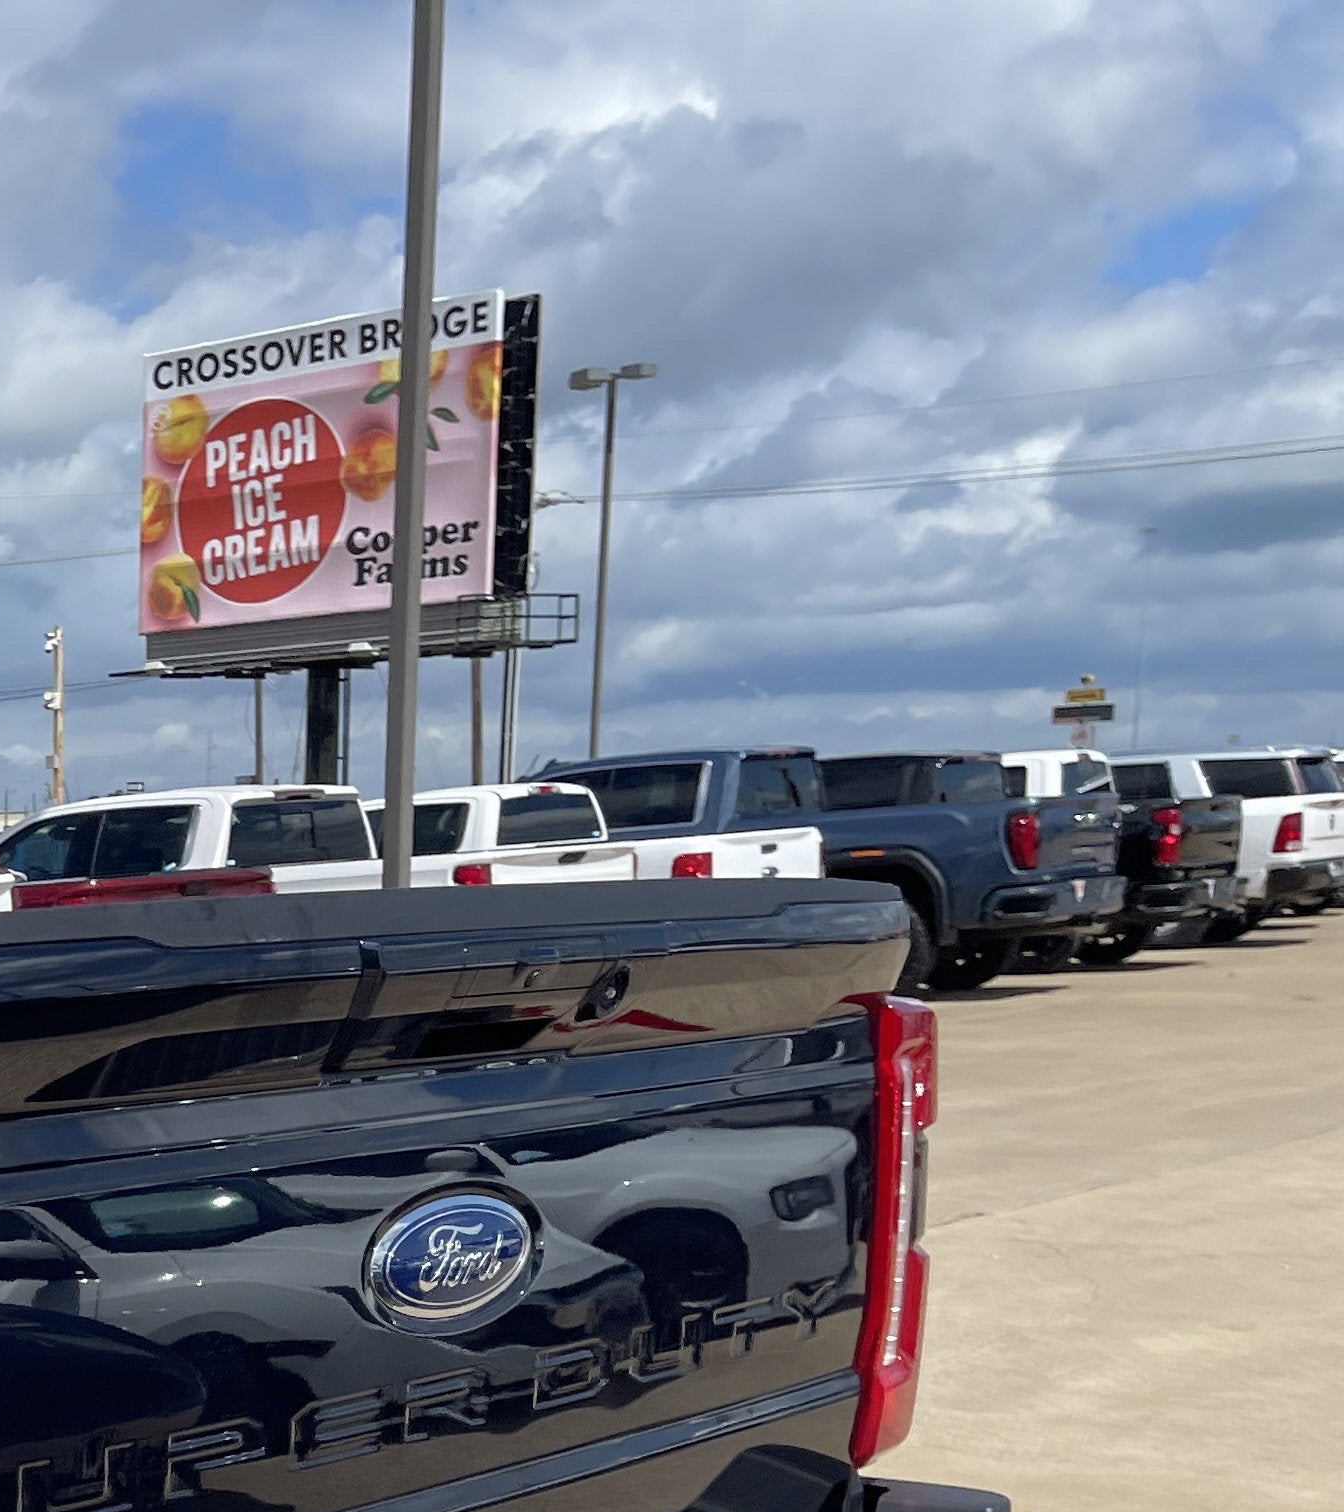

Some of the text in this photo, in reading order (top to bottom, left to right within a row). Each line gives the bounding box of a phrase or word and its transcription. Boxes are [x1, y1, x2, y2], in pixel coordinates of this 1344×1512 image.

[153, 301, 490, 391] CROSSOVER BRGE
[204, 413, 318, 488] PEACH
[230, 473, 288, 530] ICE
[345, 519, 480, 554] Coper
[201, 515, 321, 586] CREAM
[353, 554, 469, 586] Fams
[419, 1222, 504, 1293] Ford
[532, 1277, 838, 1412] DUTY
